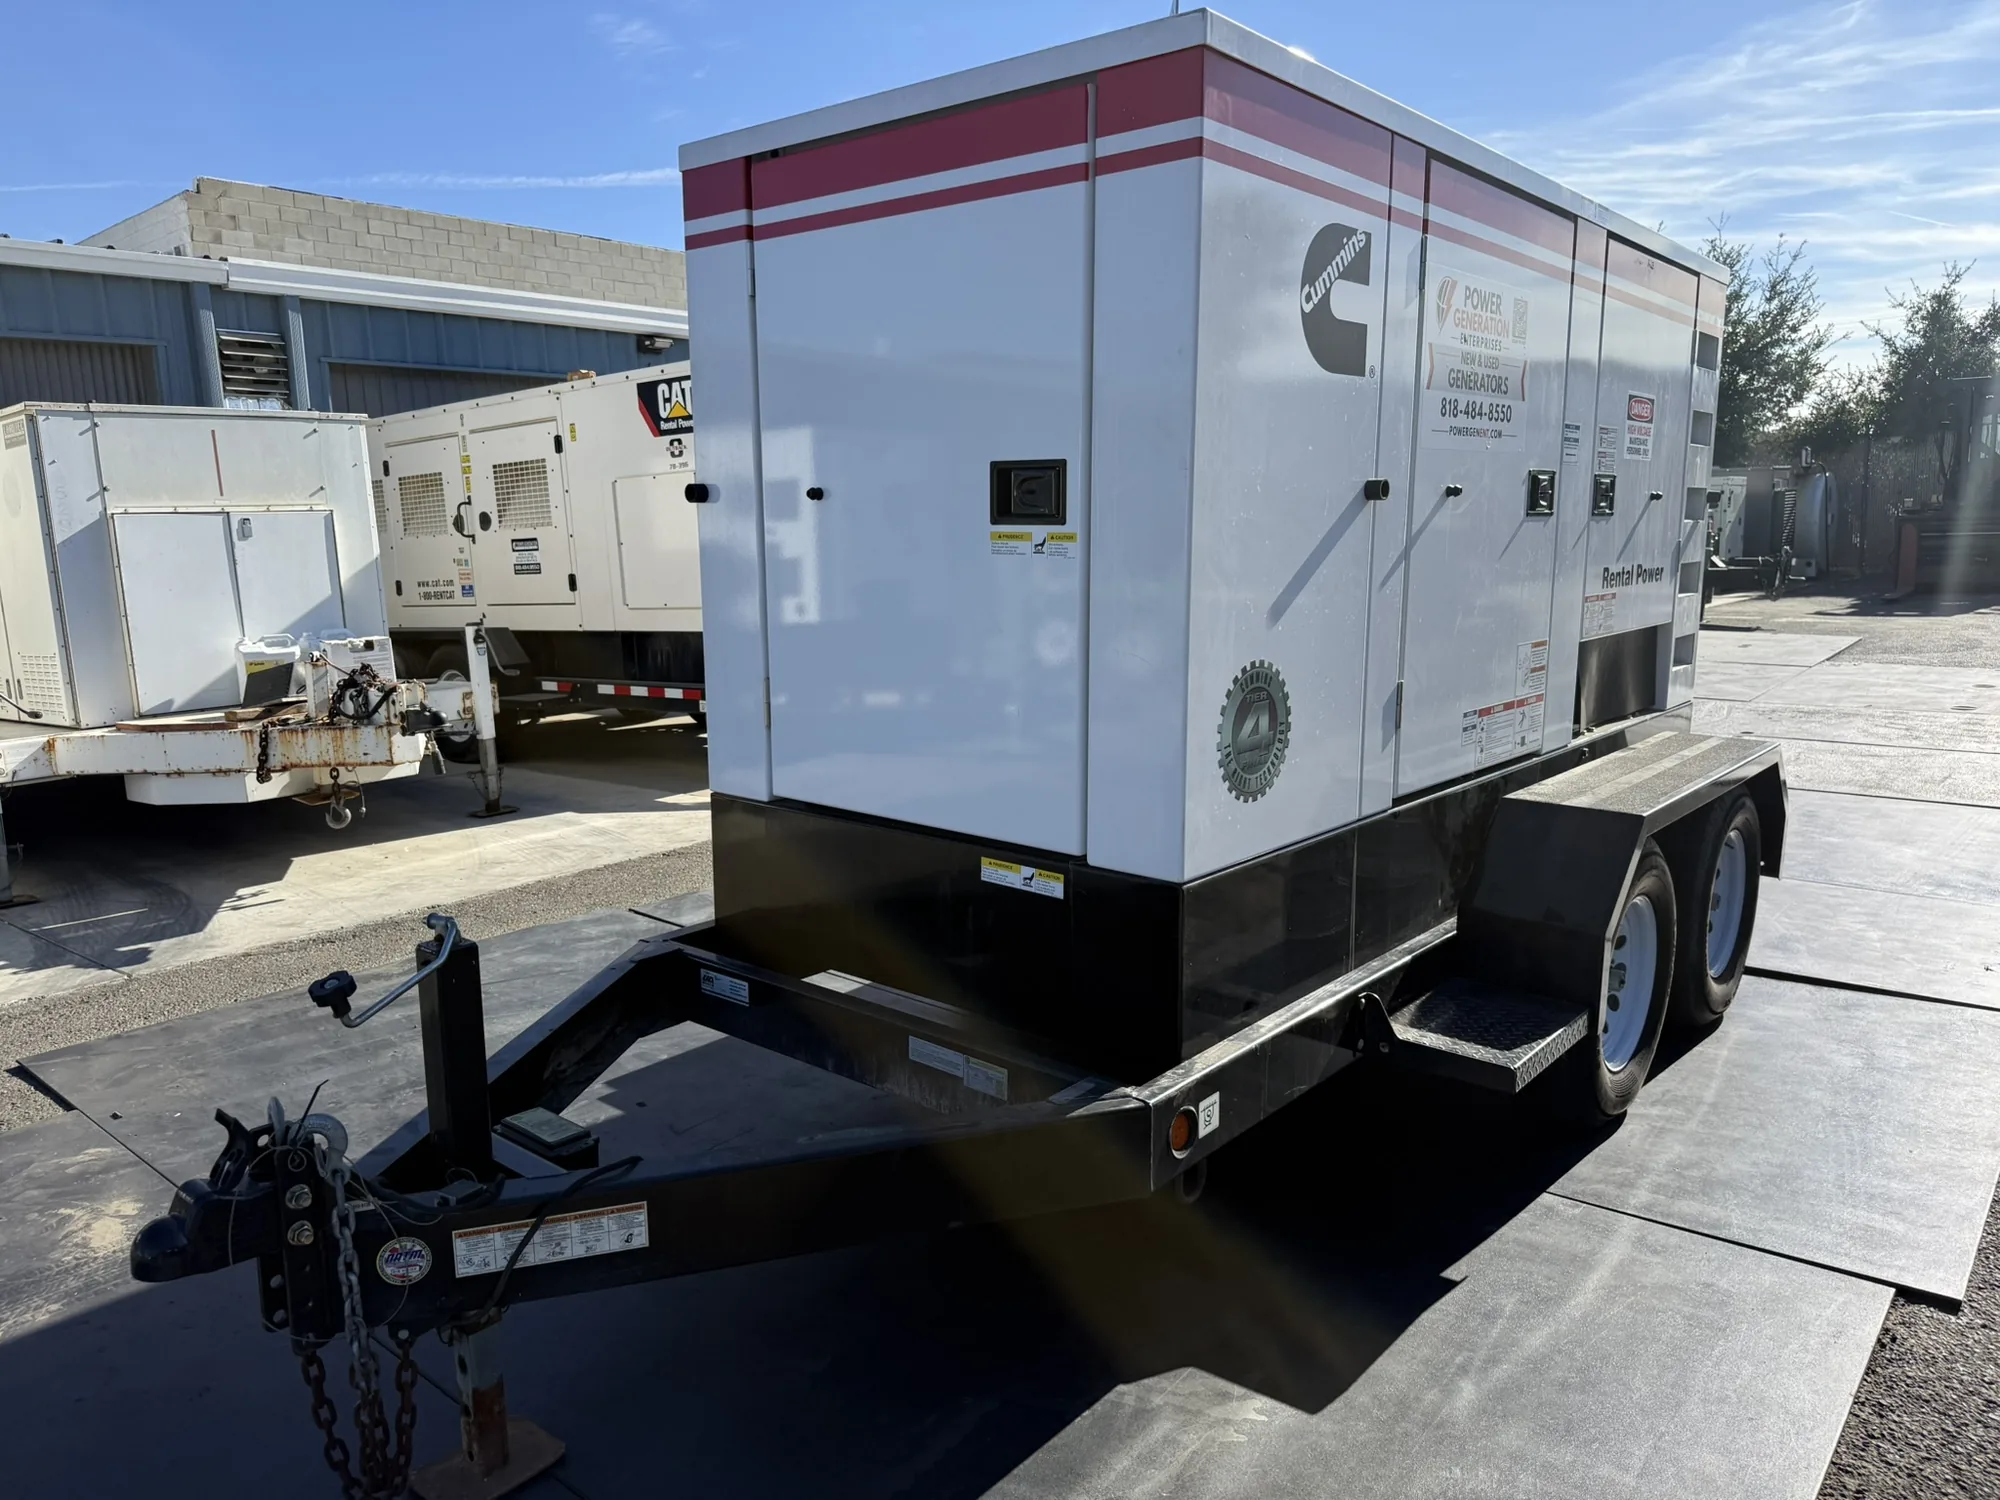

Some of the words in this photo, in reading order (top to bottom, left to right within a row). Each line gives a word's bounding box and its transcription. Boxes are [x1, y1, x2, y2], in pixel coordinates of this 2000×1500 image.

[1301, 229, 1366, 314] Cummins
[1464, 285, 1502, 316] POWER
[1453, 308, 1510, 338] GENERATION
[1460, 333, 1502, 352] ENTERPRISES
[1461, 352, 1476, 367] NEW
[1477, 355, 1483, 368] &
[1483, 356, 1500, 370] USED
[1447, 367, 1509, 396] GENERATORS
[657, 379, 692, 419] CAT
[1440, 397, 1512, 423] 818-484-8550
[660, 420, 677, 430] Rental
[678, 418, 694, 429] Powe
[1449, 426, 1502, 439] POWERGENENT.COM
[417, 579, 454, 588] www.cat.com
[1602, 564, 1634, 589] Rental
[1636, 563, 1664, 584] Power
[418, 590, 455, 601] 1-800-RENTCAT
[1240, 671, 1273, 693] CUMMINS
[1245, 690, 1269, 703] TIER
[1236, 700, 1275, 757] 4
[1224, 743, 1234, 765] THE
